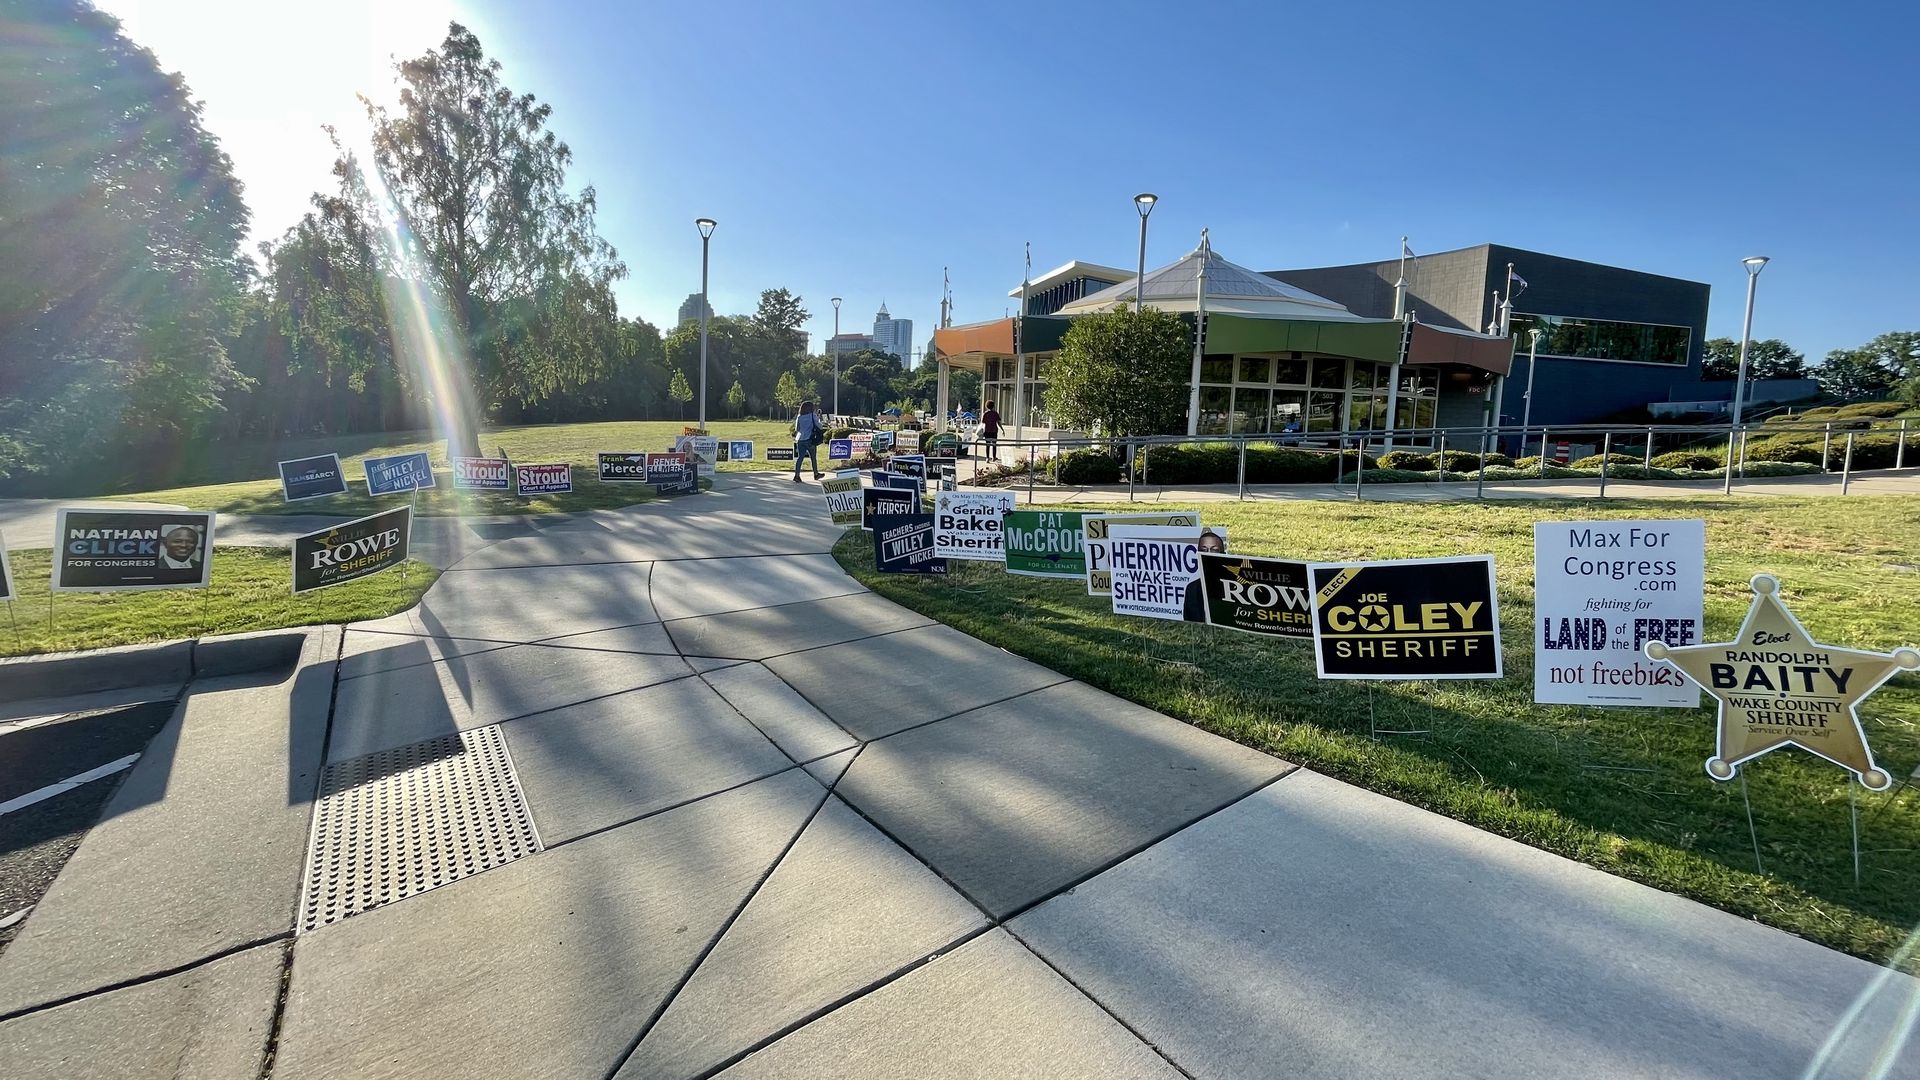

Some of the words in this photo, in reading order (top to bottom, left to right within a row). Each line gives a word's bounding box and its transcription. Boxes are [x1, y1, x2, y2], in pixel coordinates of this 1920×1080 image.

[382, 460, 414, 481] WILEY
[456, 461, 507, 479] Stroud
[520, 468, 568, 486] Stroud
[602, 463, 644, 473] Pierce
[647, 464, 684, 473] ELLMERS
[393, 470, 428, 489] NICKEL
[822, 480, 850, 494] Shaun
[825, 492, 864, 513] Pollen
[953, 504, 995, 516] Gerald
[1039, 513, 1064, 528] PAT
[70, 529, 159, 539] NATHAN
[882, 523, 914, 541] TEACHERS
[1007, 527, 1085, 553] McCROR
[1570, 529, 1621, 548] Max
[1630, 528, 1671, 548] For
[69, 540, 157, 555] CLICK
[310, 528, 400, 570] ROWE
[892, 533, 925, 556] WILEY
[936, 535, 1005, 550] Sherif
[320, 567, 338, 578] for
[340, 548, 394, 572] SHERIFF
[909, 549, 936, 565] NICKEL
[1111, 541, 1199, 574] HERRING
[1242, 570, 1291, 583] WILLIE
[1564, 557, 1677, 580] Congress
[1091, 573, 1111, 589] Cou
[1129, 570, 1171, 586] WAKE
[1171, 575, 1190, 583] COUNTY
[1323, 572, 1349, 598] ELECT
[1633, 580, 1677, 591] .com
[1114, 582, 1185, 605] SHERIFF
[1219, 579, 1311, 611] ROW
[1358, 593, 1388, 603] JOE
[1582, 598, 1631, 612] fighting
[1632, 598, 1653, 612] for
[1234, 606, 1253, 618] for
[1256, 609, 1312, 625] SHERI
[1327, 601, 1483, 632] COLEY
[1544, 617, 1607, 651] LAND
[1615, 623, 1628, 635] of
[1633, 618, 1696, 652] FREE
[1611, 639, 1630, 651] the
[1752, 631, 1791, 646] Elect
[1335, 639, 1480, 658] SHERIFF
[1725, 651, 1830, 667] RANDOLPH
[1549, 664, 1585, 685] not
[1709, 662, 1854, 696] BAITY
[1727, 697, 1771, 710] WAKE
[1774, 699, 1842, 713] COUNTY
[1746, 710, 1828, 728] SHERIFF
[1785, 727, 1810, 737] Over
